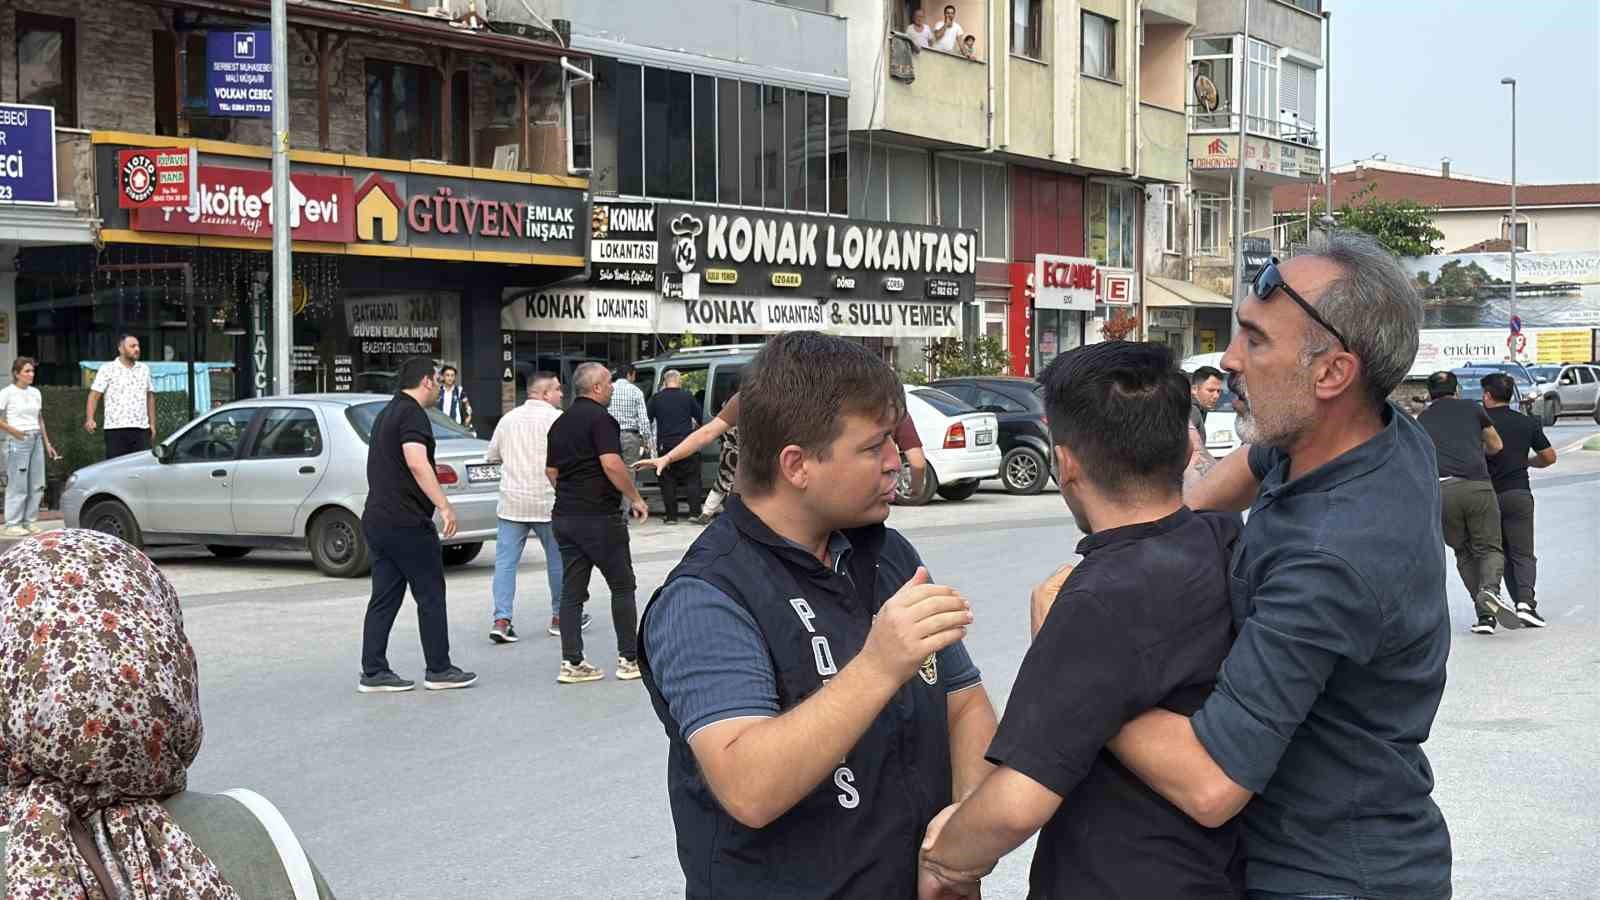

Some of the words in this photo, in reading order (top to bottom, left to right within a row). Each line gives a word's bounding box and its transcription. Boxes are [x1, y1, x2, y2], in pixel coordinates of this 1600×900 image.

[214, 87, 248, 100] VOLKAN
[304, 193, 339, 224] evi
[408, 187, 524, 238] GÜVEN
[527, 205, 574, 223] EMLAK
[609, 208, 655, 232] KONAK
[526, 219, 575, 242] İNŞAAT
[600, 242, 655, 260] LOKANTASI
[706, 214, 818, 267] KONAK
[825, 224, 975, 274] LOKANTASI
[836, 276, 856, 289] DÖNER
[1043, 261, 1096, 290] ECZANE
[1110, 281, 1125, 299] E
[525, 293, 586, 320] KONAK
[596, 298, 648, 319] LOKANTASI
[684, 299, 756, 326] KONAK
[767, 305, 823, 325] LOKANTASI
[831, 303, 844, 325] &
[848, 303, 892, 326] SULU
[895, 304, 955, 327] YEMEK
[353, 323, 382, 338] GÜVEN
[382, 325, 410, 338] EMLAK
[411, 324, 439, 340] İNŞAAT
[1443, 343, 1496, 357] enderin
[789, 597, 861, 809] POS
